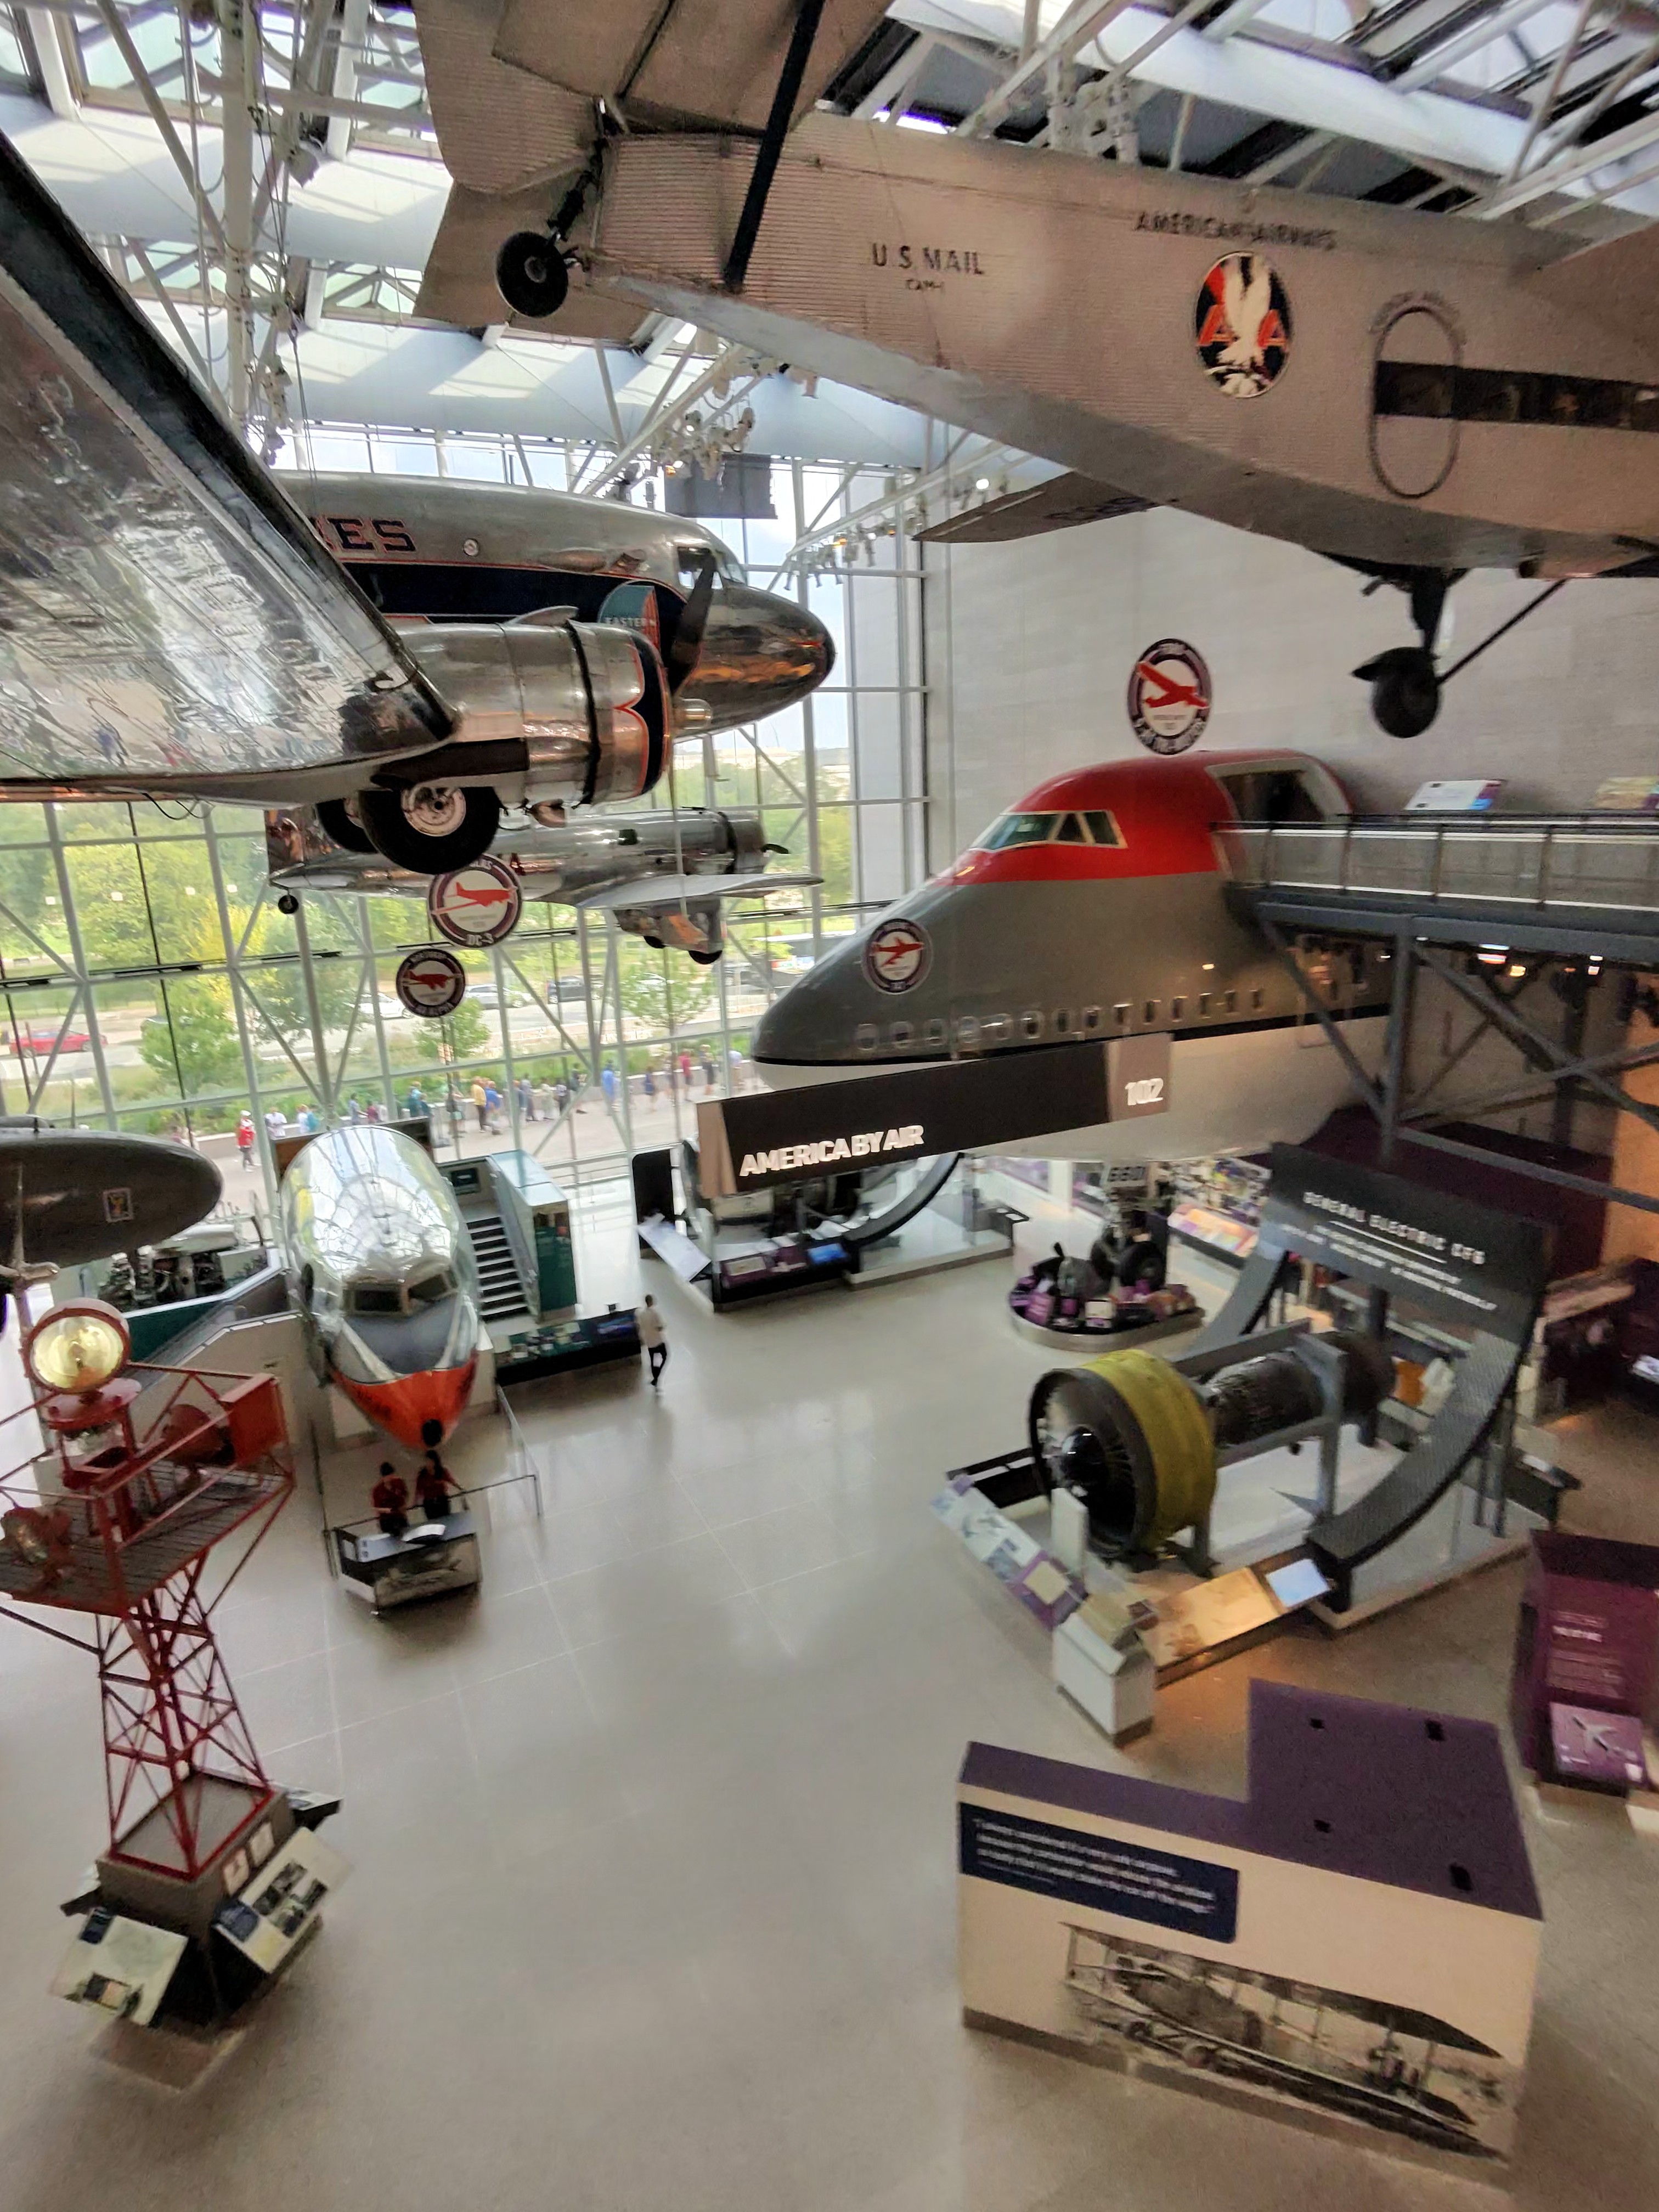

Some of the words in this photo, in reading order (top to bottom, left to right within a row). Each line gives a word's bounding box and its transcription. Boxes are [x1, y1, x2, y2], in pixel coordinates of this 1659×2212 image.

[923, 246, 985, 275] MAIL
[309, 517, 416, 551] ES
[1124, 1079, 1164, 1106] 102
[740, 1138, 851, 1177] AMERICA
[851, 1131, 884, 1156] BY
[883, 1125, 924, 1151] AIR
